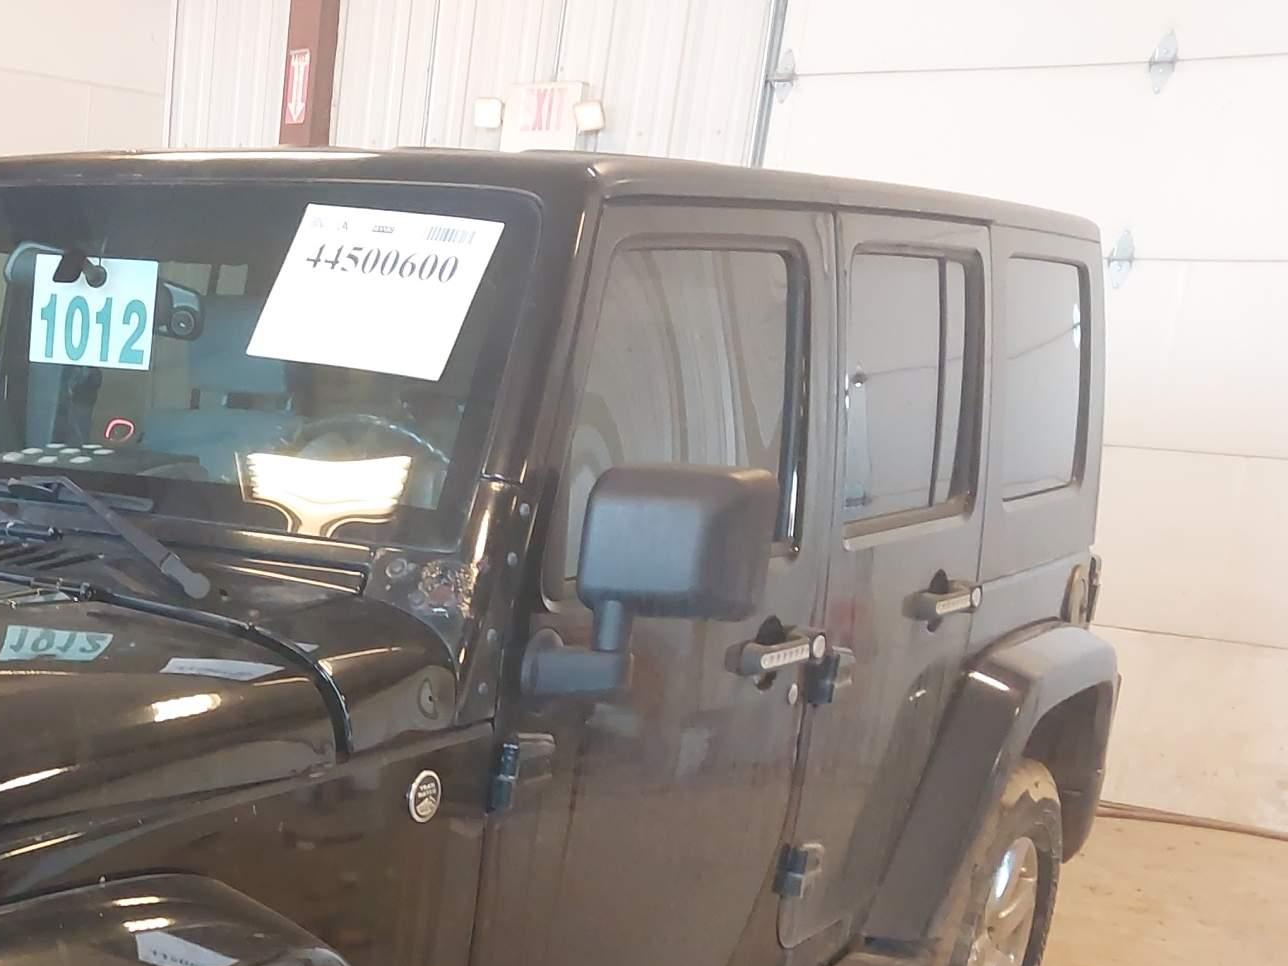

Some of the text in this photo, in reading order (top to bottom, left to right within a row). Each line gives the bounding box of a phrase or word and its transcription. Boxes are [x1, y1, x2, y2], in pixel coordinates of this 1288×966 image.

[520, 88, 568, 132] XIT
[306, 242, 460, 284] 44500600
[40, 293, 148, 365] 1012
